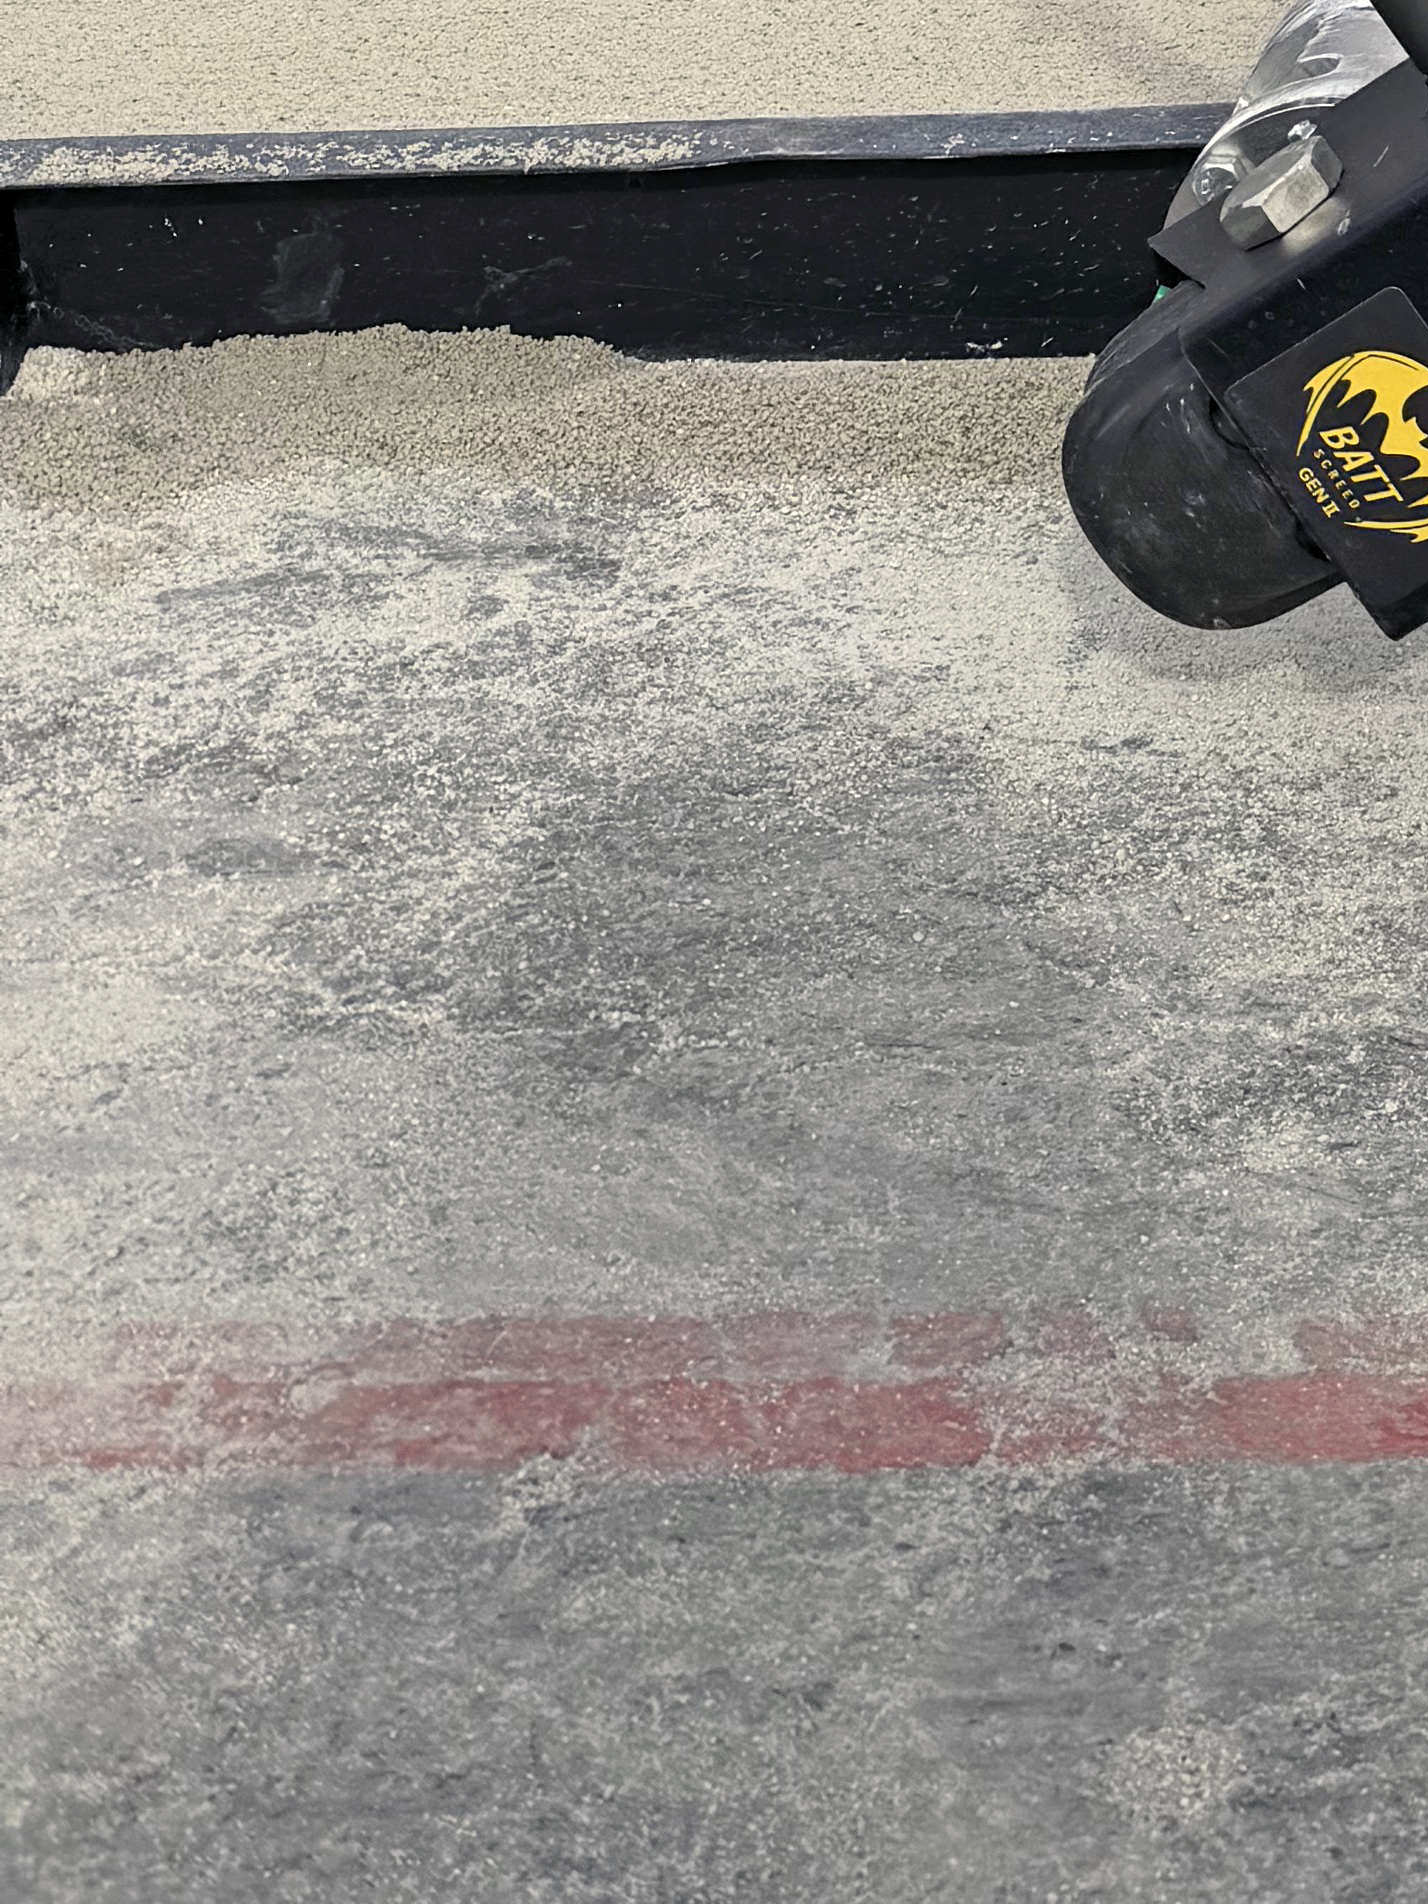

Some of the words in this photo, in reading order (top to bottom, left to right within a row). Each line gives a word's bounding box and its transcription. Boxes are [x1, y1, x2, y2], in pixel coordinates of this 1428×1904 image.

[1299, 467, 1330, 504] GEN
[1313, 448, 1361, 509] SCREED
[1319, 426, 1404, 502] BATT
